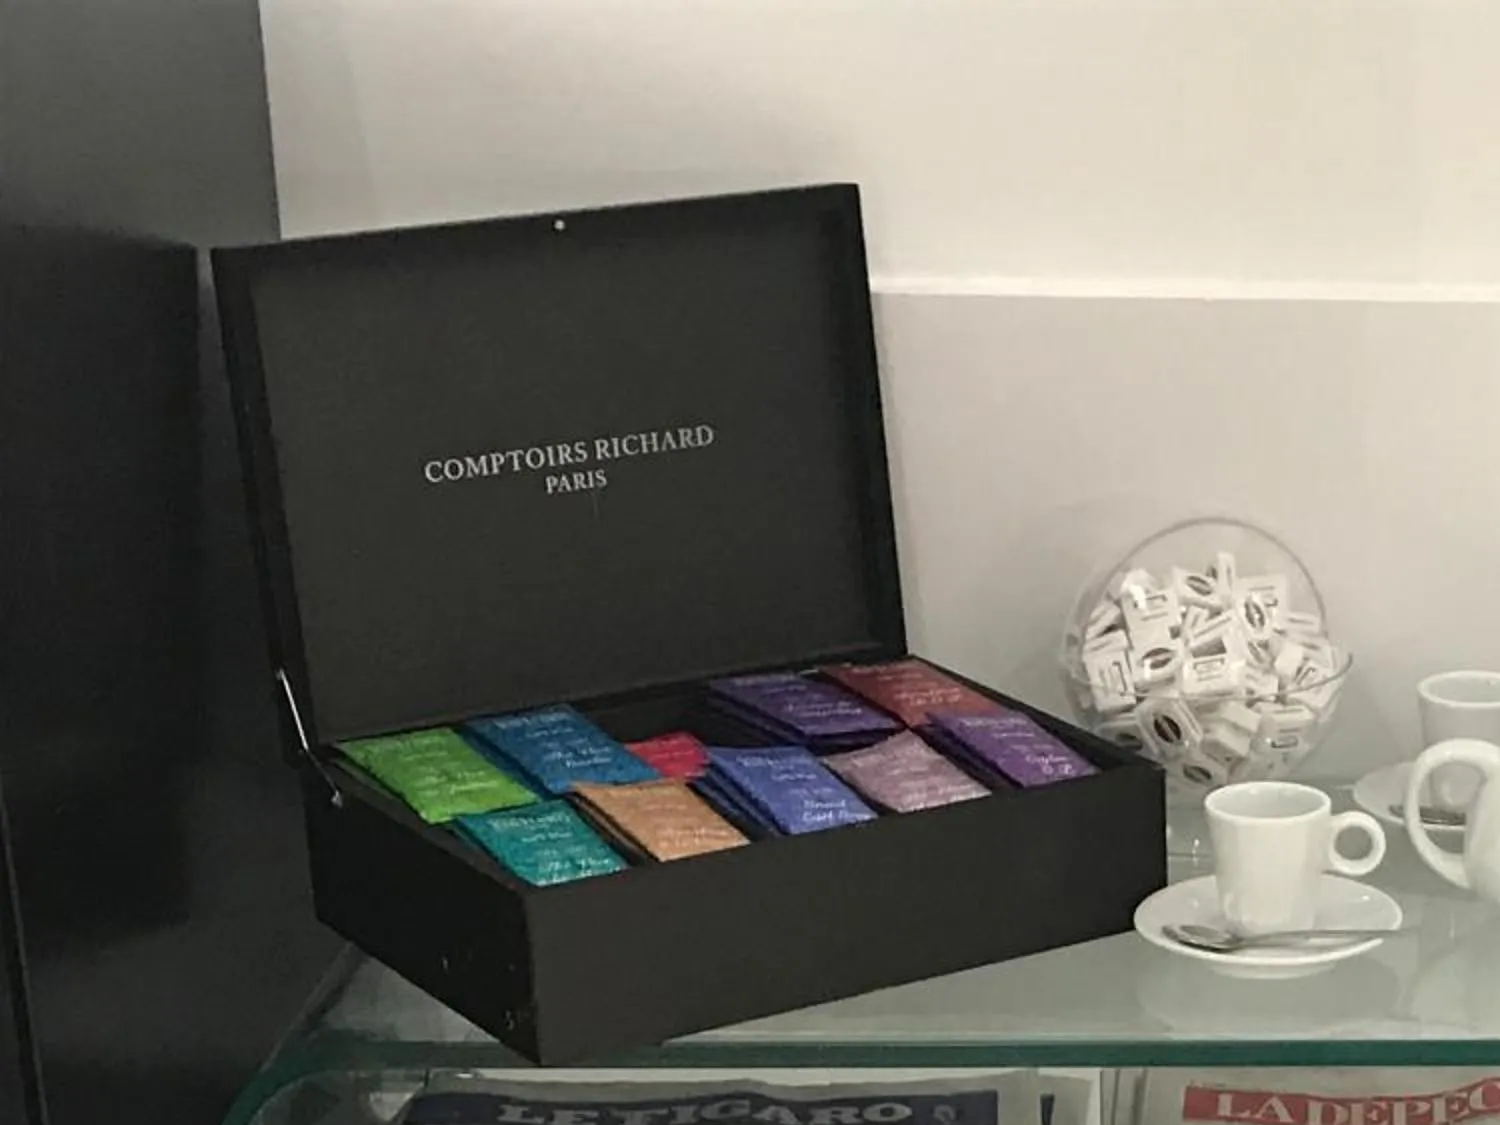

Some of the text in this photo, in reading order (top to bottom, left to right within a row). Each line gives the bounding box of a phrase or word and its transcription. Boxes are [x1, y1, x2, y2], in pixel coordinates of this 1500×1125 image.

[424, 424, 715, 483] COMPTOIRS RICHARD
[545, 469, 608, 495] PARIS
